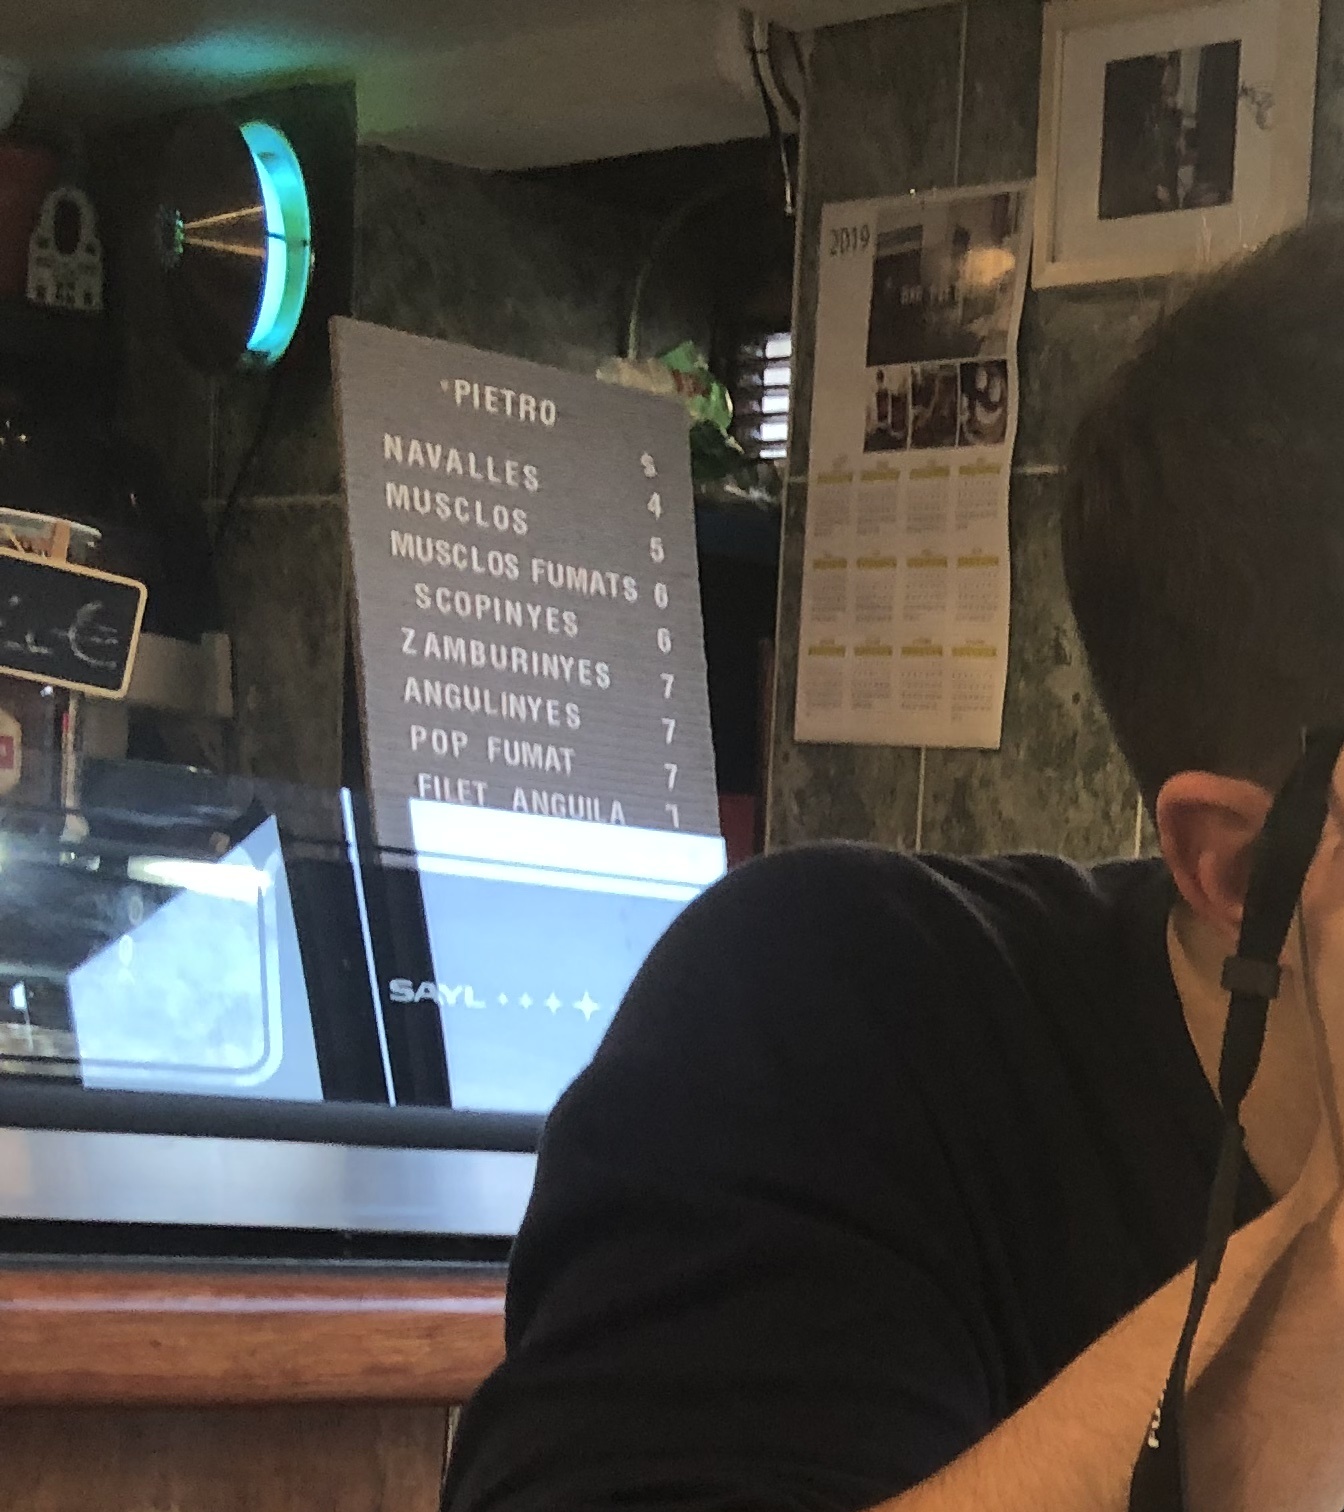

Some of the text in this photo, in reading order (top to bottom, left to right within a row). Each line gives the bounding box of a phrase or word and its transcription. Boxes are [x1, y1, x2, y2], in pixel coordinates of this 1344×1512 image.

[384, 433, 662, 520] NAVALLES 4
[385, 482, 665, 563] MUSCLOS 5
[390, 530, 519, 580] MUSCLOS
[531, 556, 638, 602] FUMATS
[414, 583, 578, 638] SCOPINYES
[404, 676, 676, 744] ANGULINYES 7
[660, 672, 675, 699] 7
[410, 724, 678, 791] POP FUMAT 7
[418, 773, 488, 806] FILET
[389, 977, 487, 1010] SAYL
